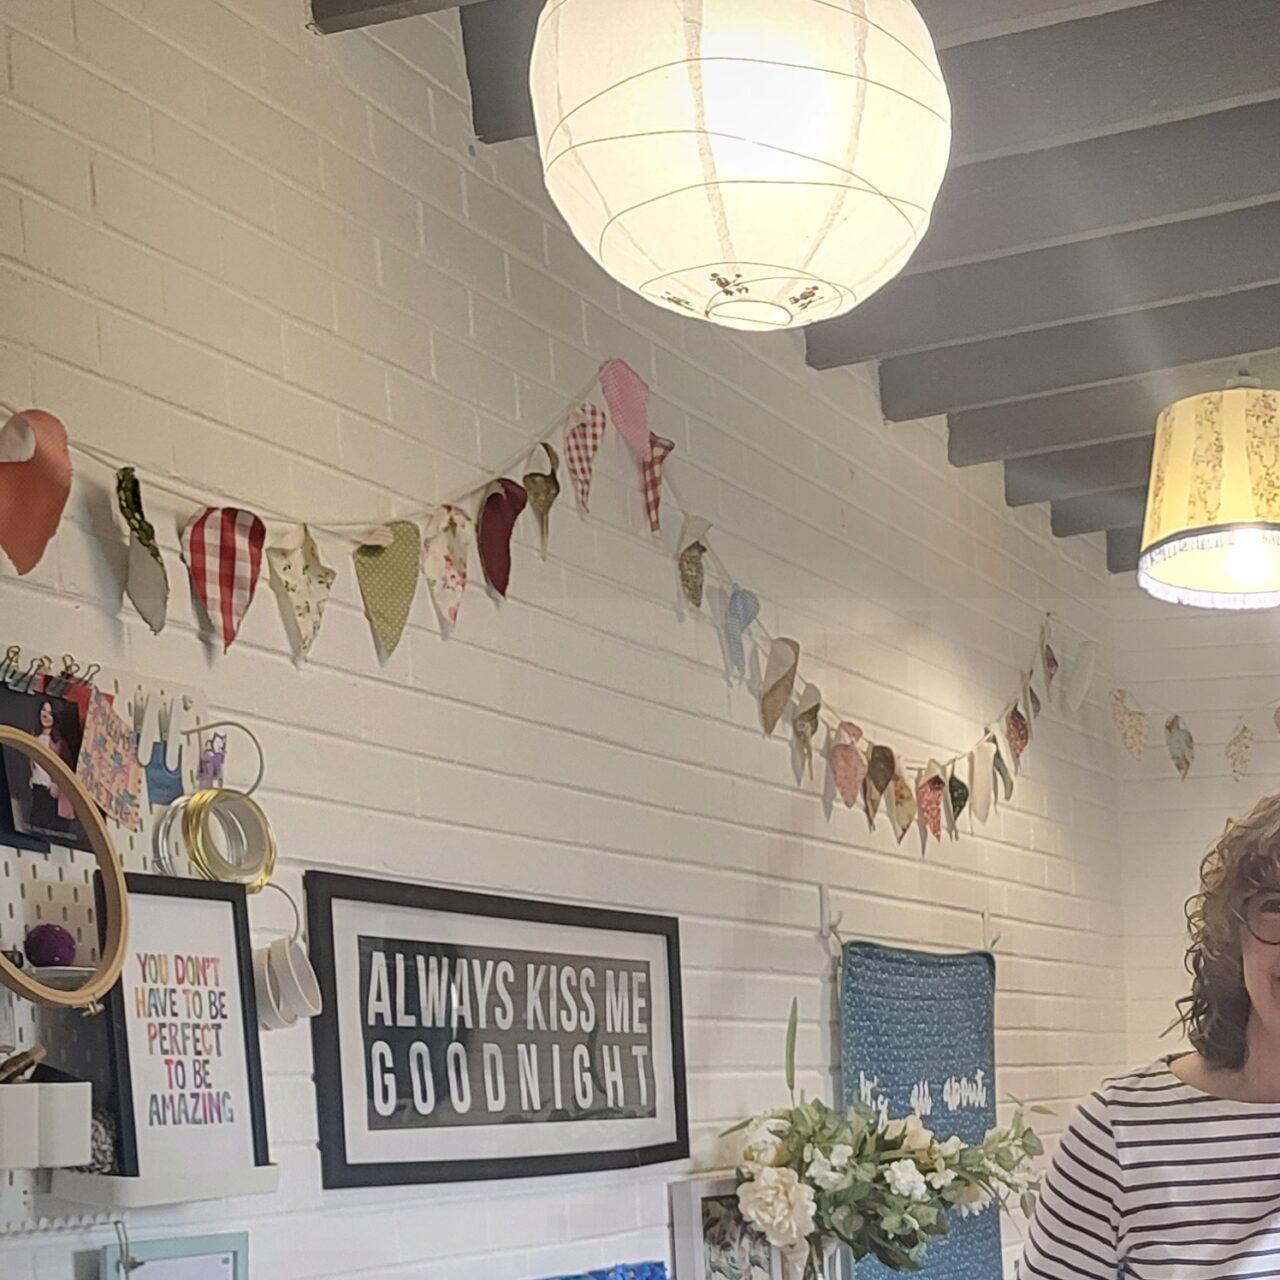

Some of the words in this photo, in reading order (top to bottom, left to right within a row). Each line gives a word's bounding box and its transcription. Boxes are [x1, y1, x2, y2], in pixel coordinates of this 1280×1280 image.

[136, 953, 169, 985] YOU
[174, 954, 221, 987] DON'T
[134, 987, 178, 1019] HAVE
[182, 989, 203, 1019] TO
[208, 990, 228, 1020] BE
[367, 950, 515, 1031] ALWAYS
[526, 963, 596, 1033] KISS
[605, 969, 648, 1034] ME
[147, 1022, 222, 1057] PERFECT
[164, 1059, 186, 1090] TO
[193, 1059, 212, 1089] BE
[370, 1040, 648, 1117] GOODNIGHT
[149, 1091, 235, 1127] AMAZING
